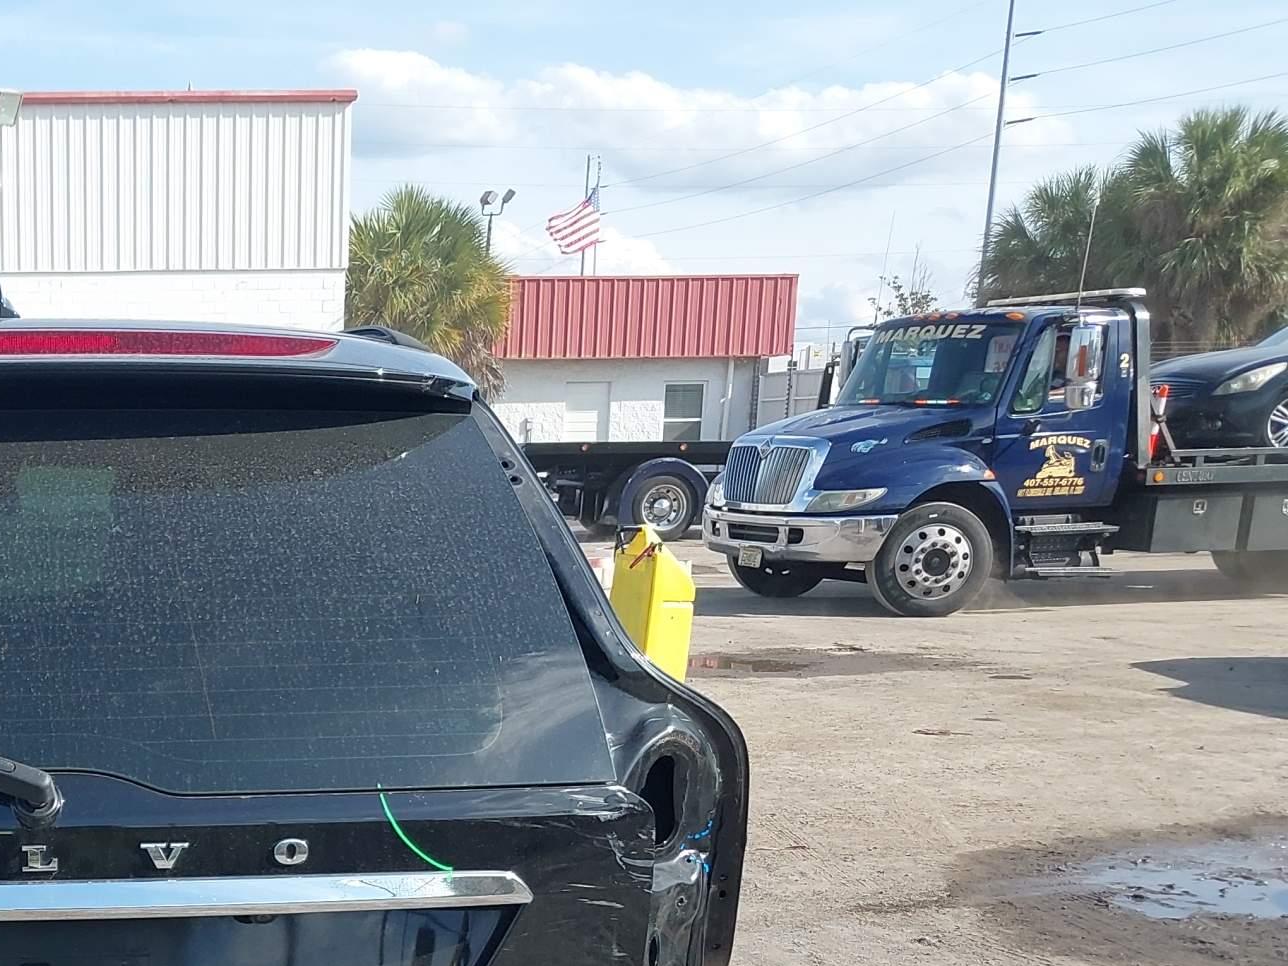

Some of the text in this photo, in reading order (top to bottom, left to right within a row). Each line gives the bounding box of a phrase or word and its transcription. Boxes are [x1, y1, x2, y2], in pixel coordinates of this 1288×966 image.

[875, 324, 987, 344] MARQUEZ
[1119, 353, 1130, 368] 2
[1029, 435, 1091, 450] MARQUEZ
